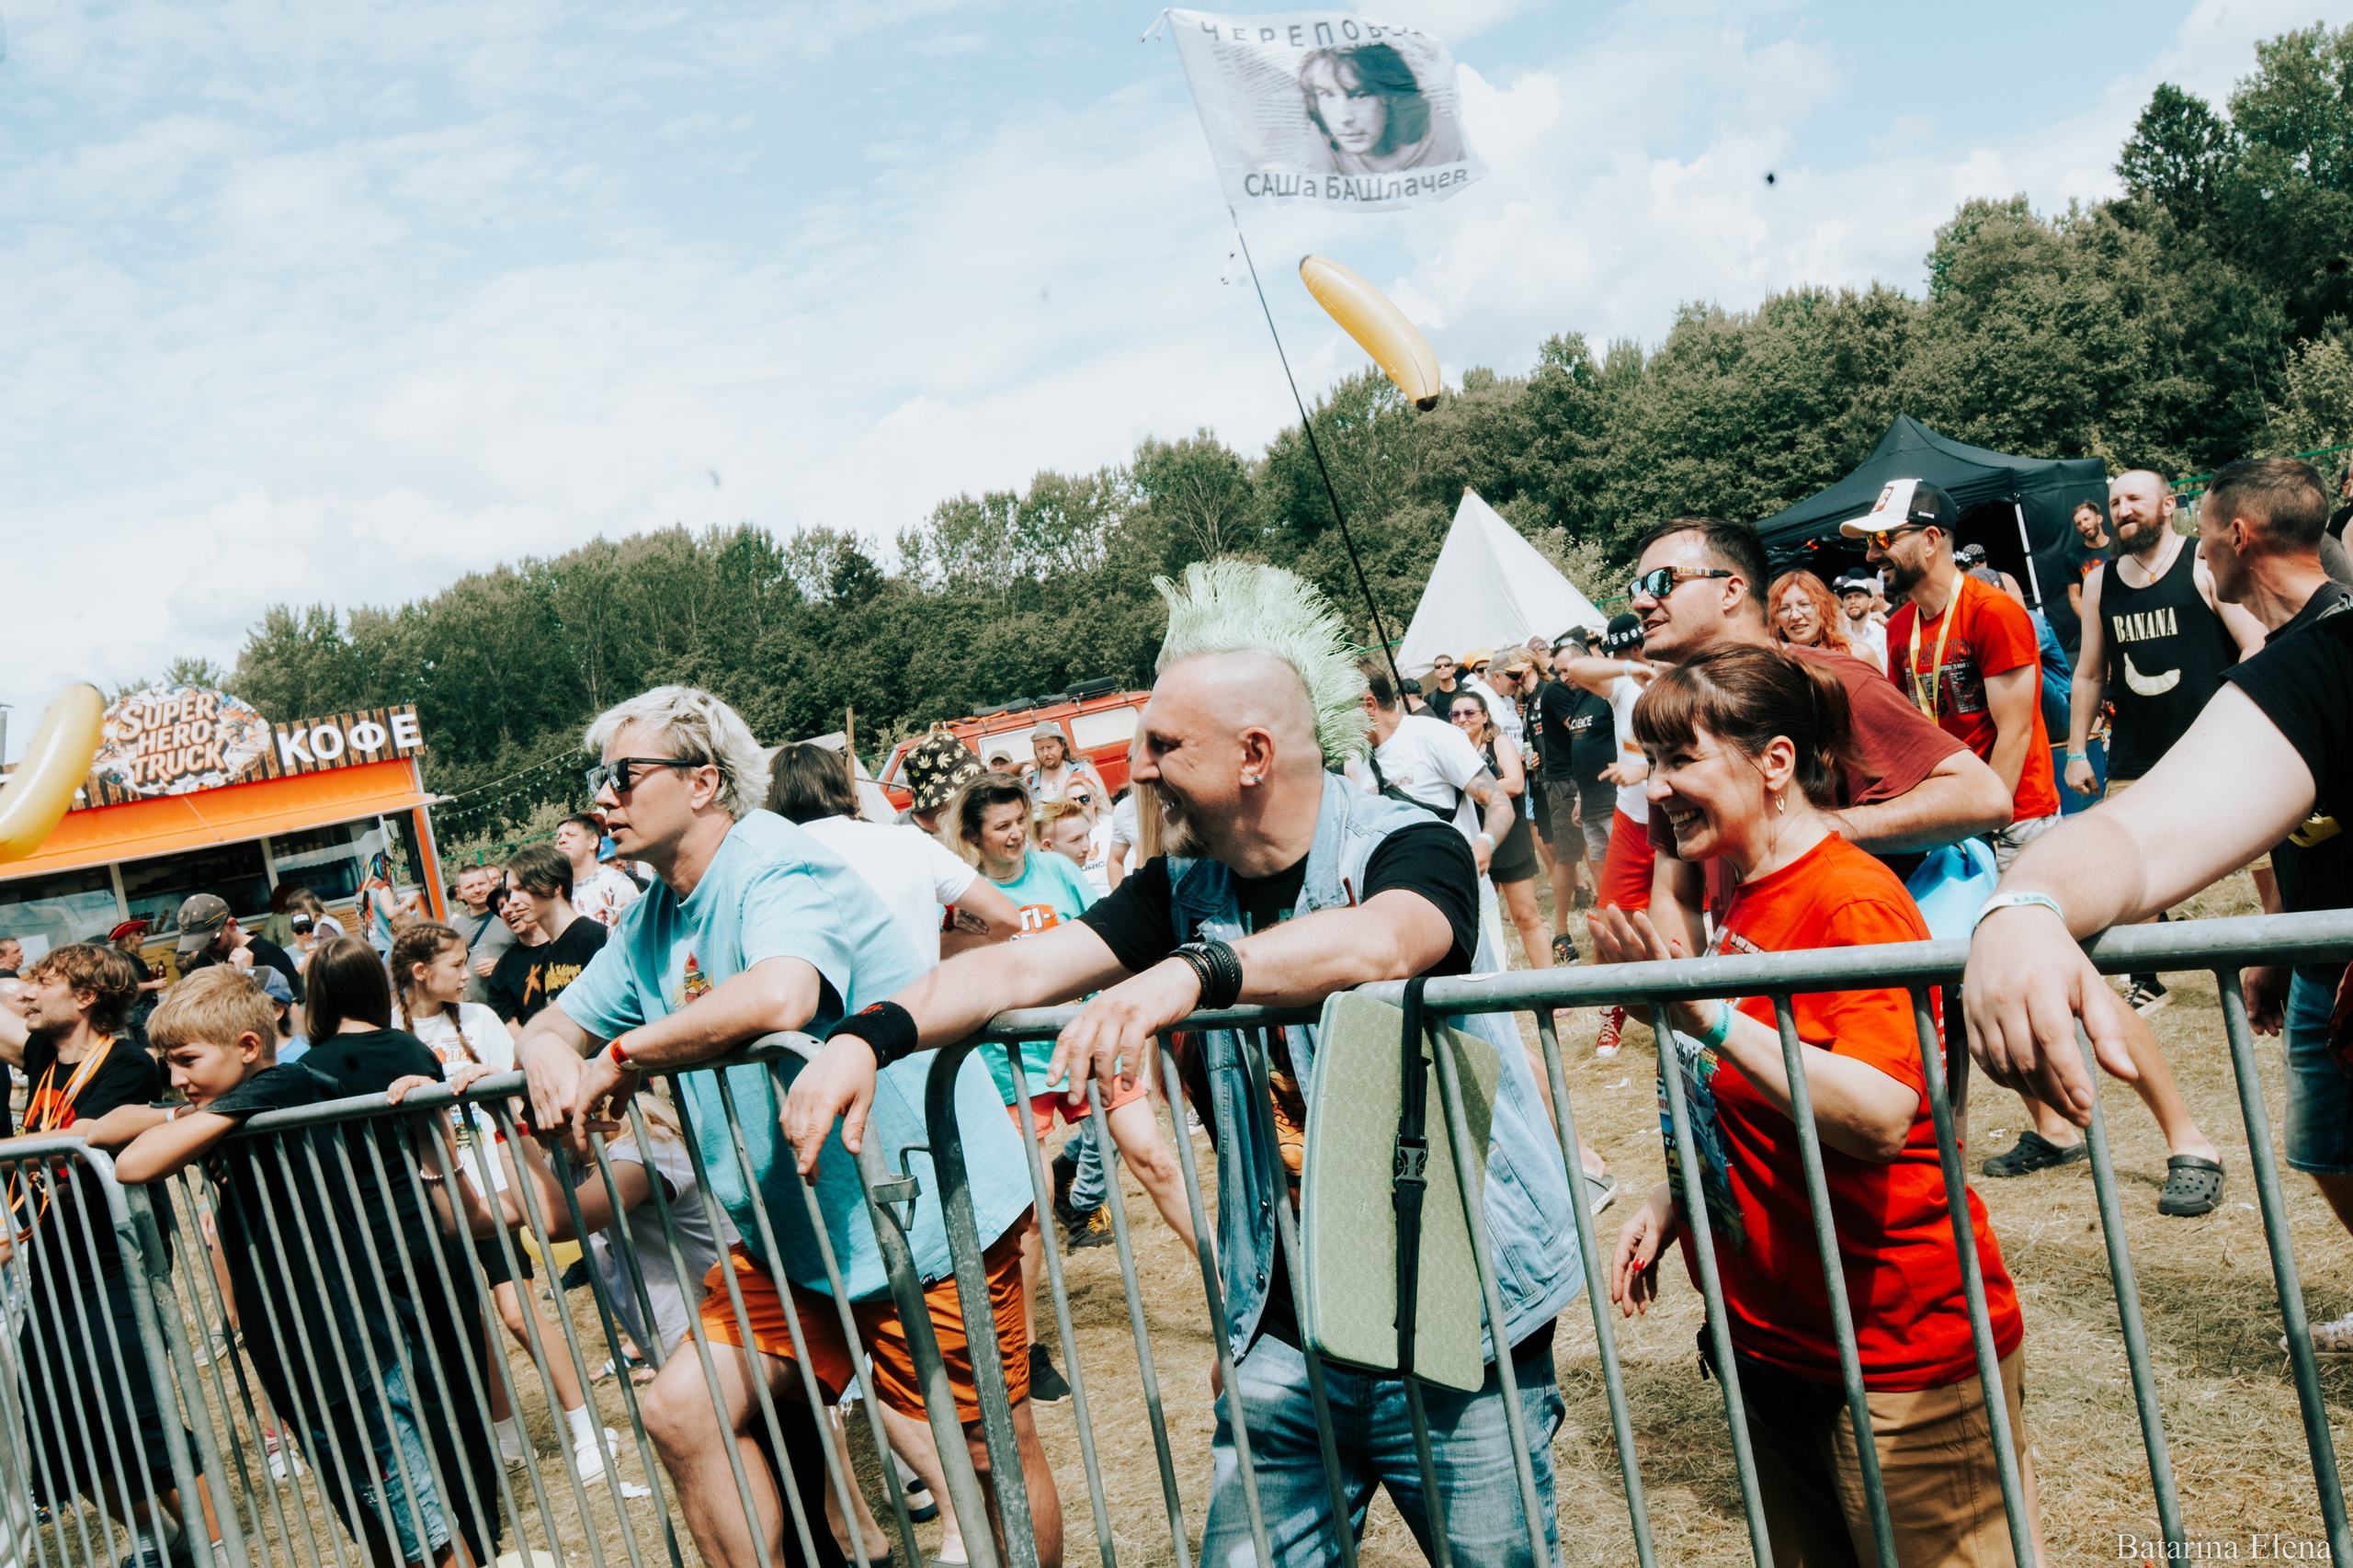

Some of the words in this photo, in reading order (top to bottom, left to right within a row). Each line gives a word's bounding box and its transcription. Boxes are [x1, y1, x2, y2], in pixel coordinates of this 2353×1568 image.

[1200, 19, 1426, 47] ЧЕРЕПОВ
[2112, 607, 2178, 643] BANANA
[117, 692, 218, 743] SUPER
[137, 719, 213, 757] HERO
[130, 738, 227, 784] TRUCK
[277, 713, 422, 767] КОФЕ
